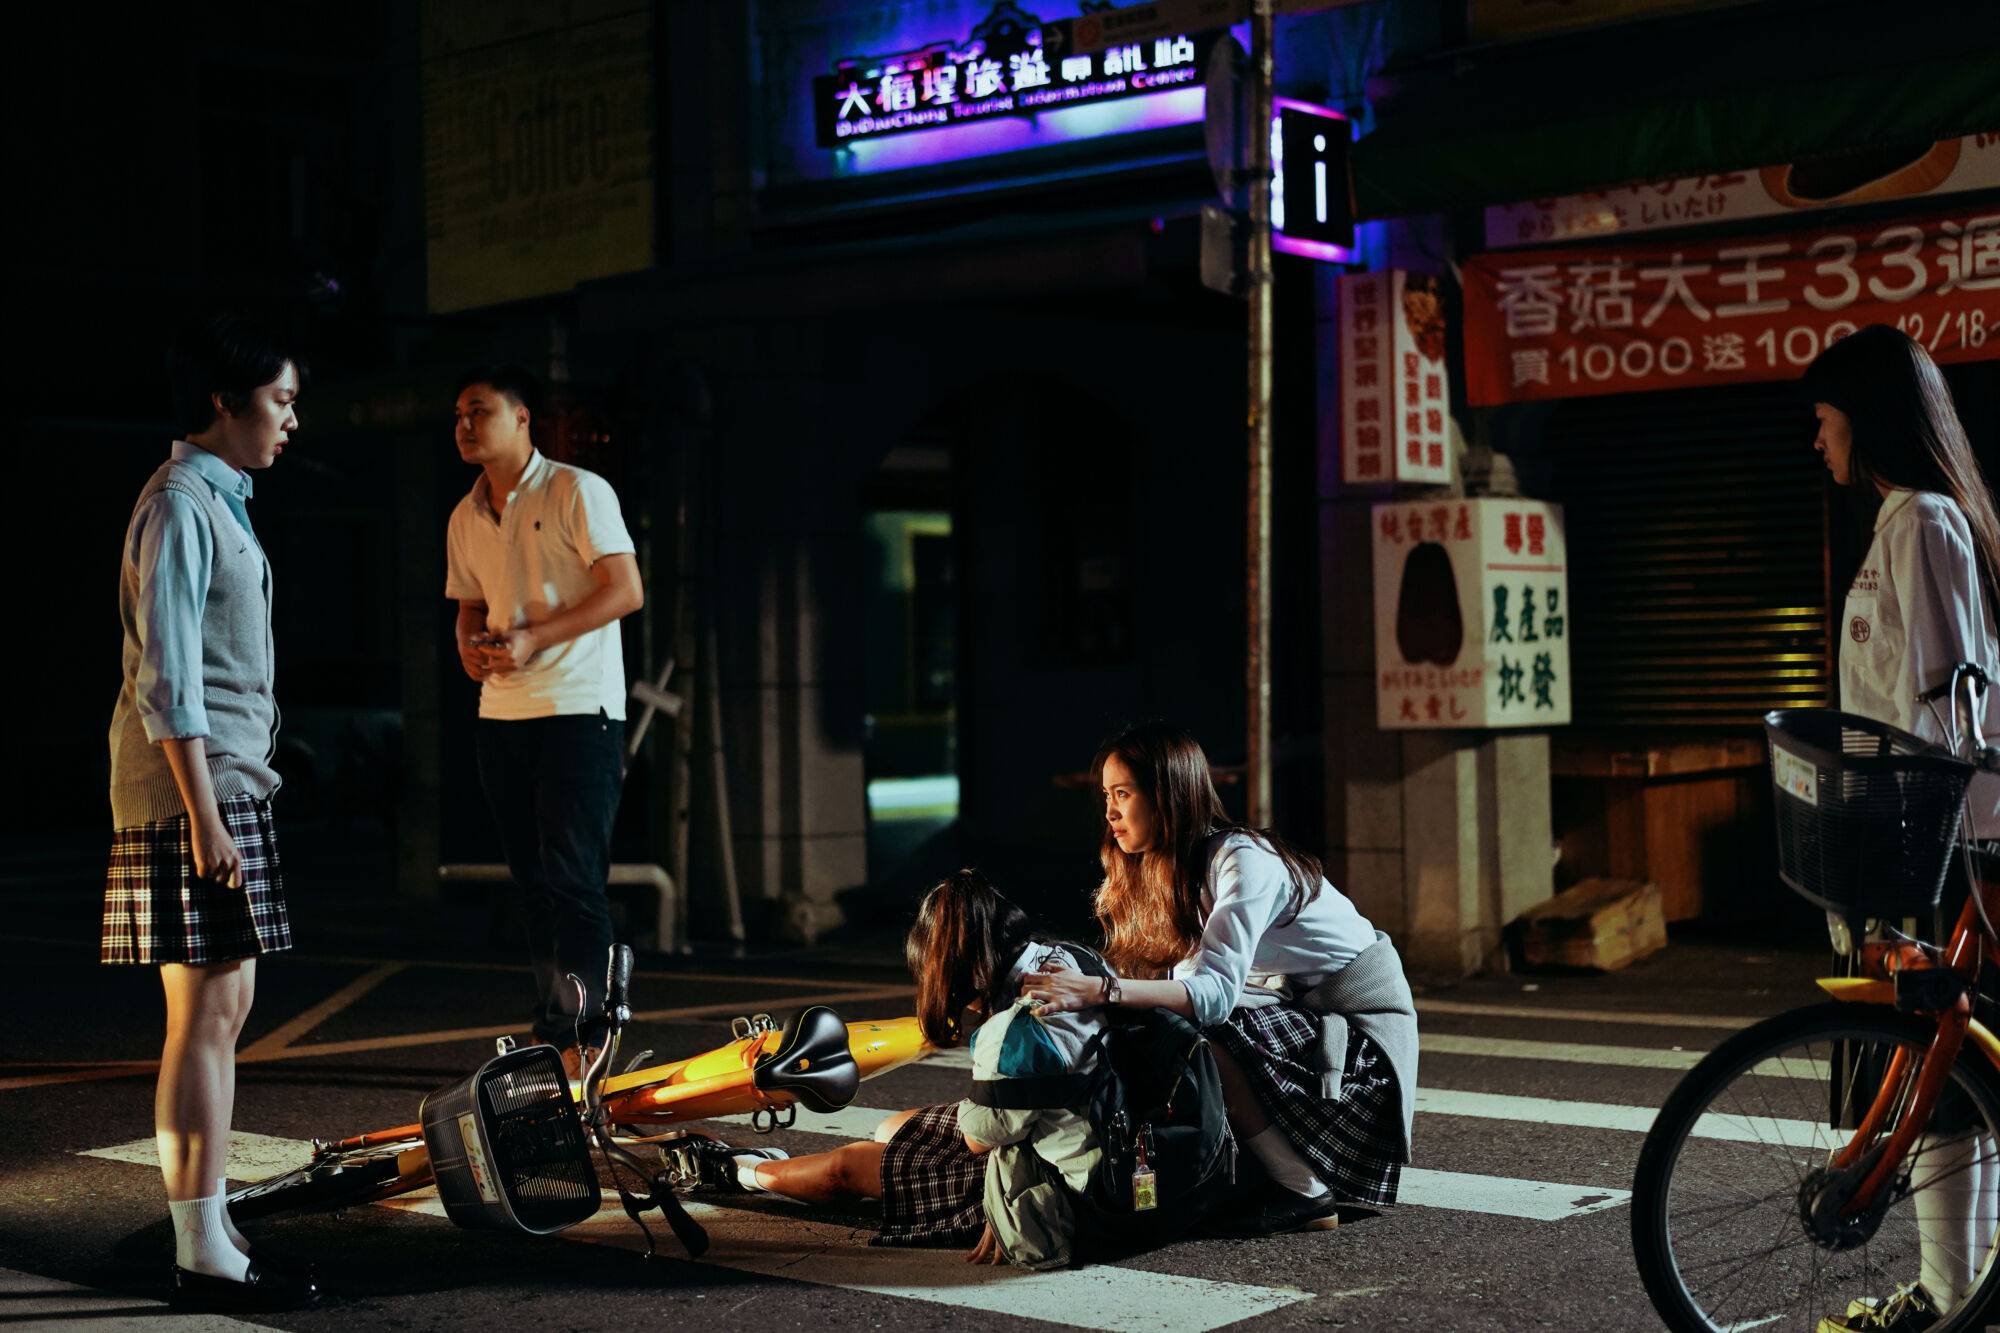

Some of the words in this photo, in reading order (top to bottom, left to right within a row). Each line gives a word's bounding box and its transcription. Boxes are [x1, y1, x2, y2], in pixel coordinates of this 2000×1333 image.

[952, 96, 1013, 118] Tourist
[1132, 67, 1196, 89] Center
[489, 71, 611, 202] Coffee
[1490, 584, 1563, 643] 農產品
[1498, 652, 1556, 710] 批發
